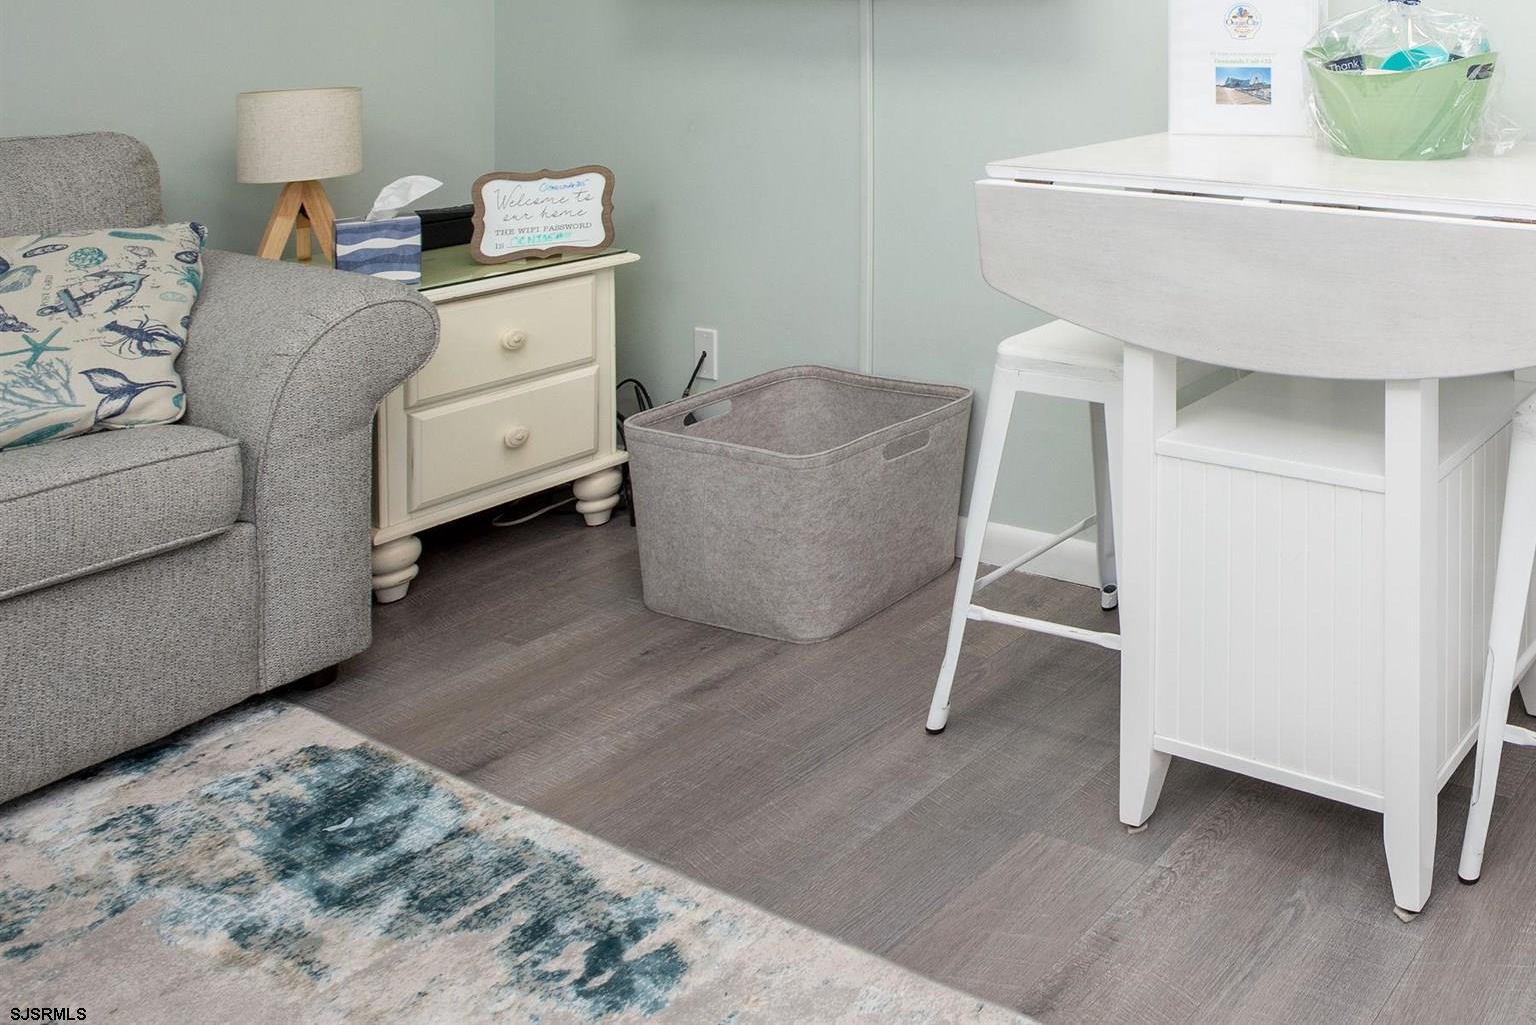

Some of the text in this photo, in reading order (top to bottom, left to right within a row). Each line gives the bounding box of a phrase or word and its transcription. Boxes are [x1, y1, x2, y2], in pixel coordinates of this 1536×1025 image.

[494, 184, 569, 210] Welcome
[573, 189, 594, 203] to
[503, 205, 588, 222] our home
[495, 222, 592, 236] THE WIFI PASSWORD
